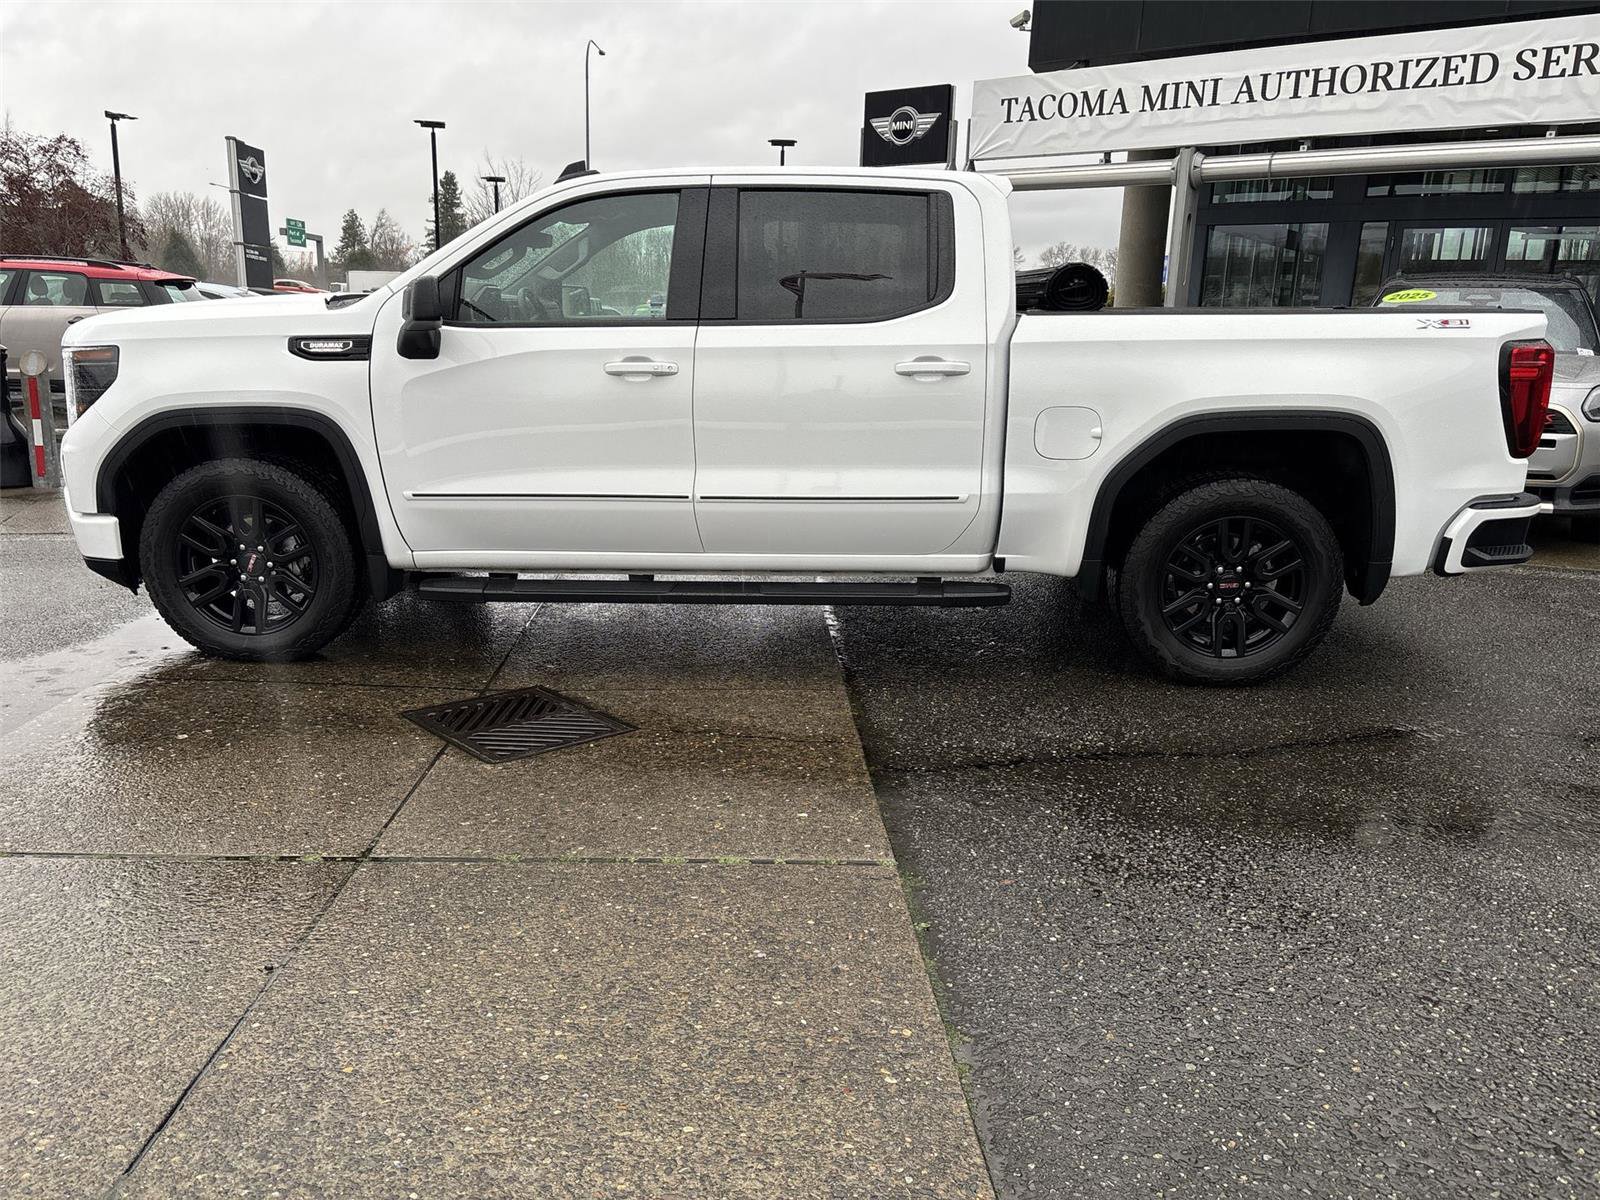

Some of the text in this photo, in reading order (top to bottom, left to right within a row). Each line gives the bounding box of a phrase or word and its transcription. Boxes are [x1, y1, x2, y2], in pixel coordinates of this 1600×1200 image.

[1000, 42, 1600, 124] TACOMA MINI AUTHORIZED SER
[892, 120, 914, 131] MINI
[1388, 292, 1431, 301] 2025
